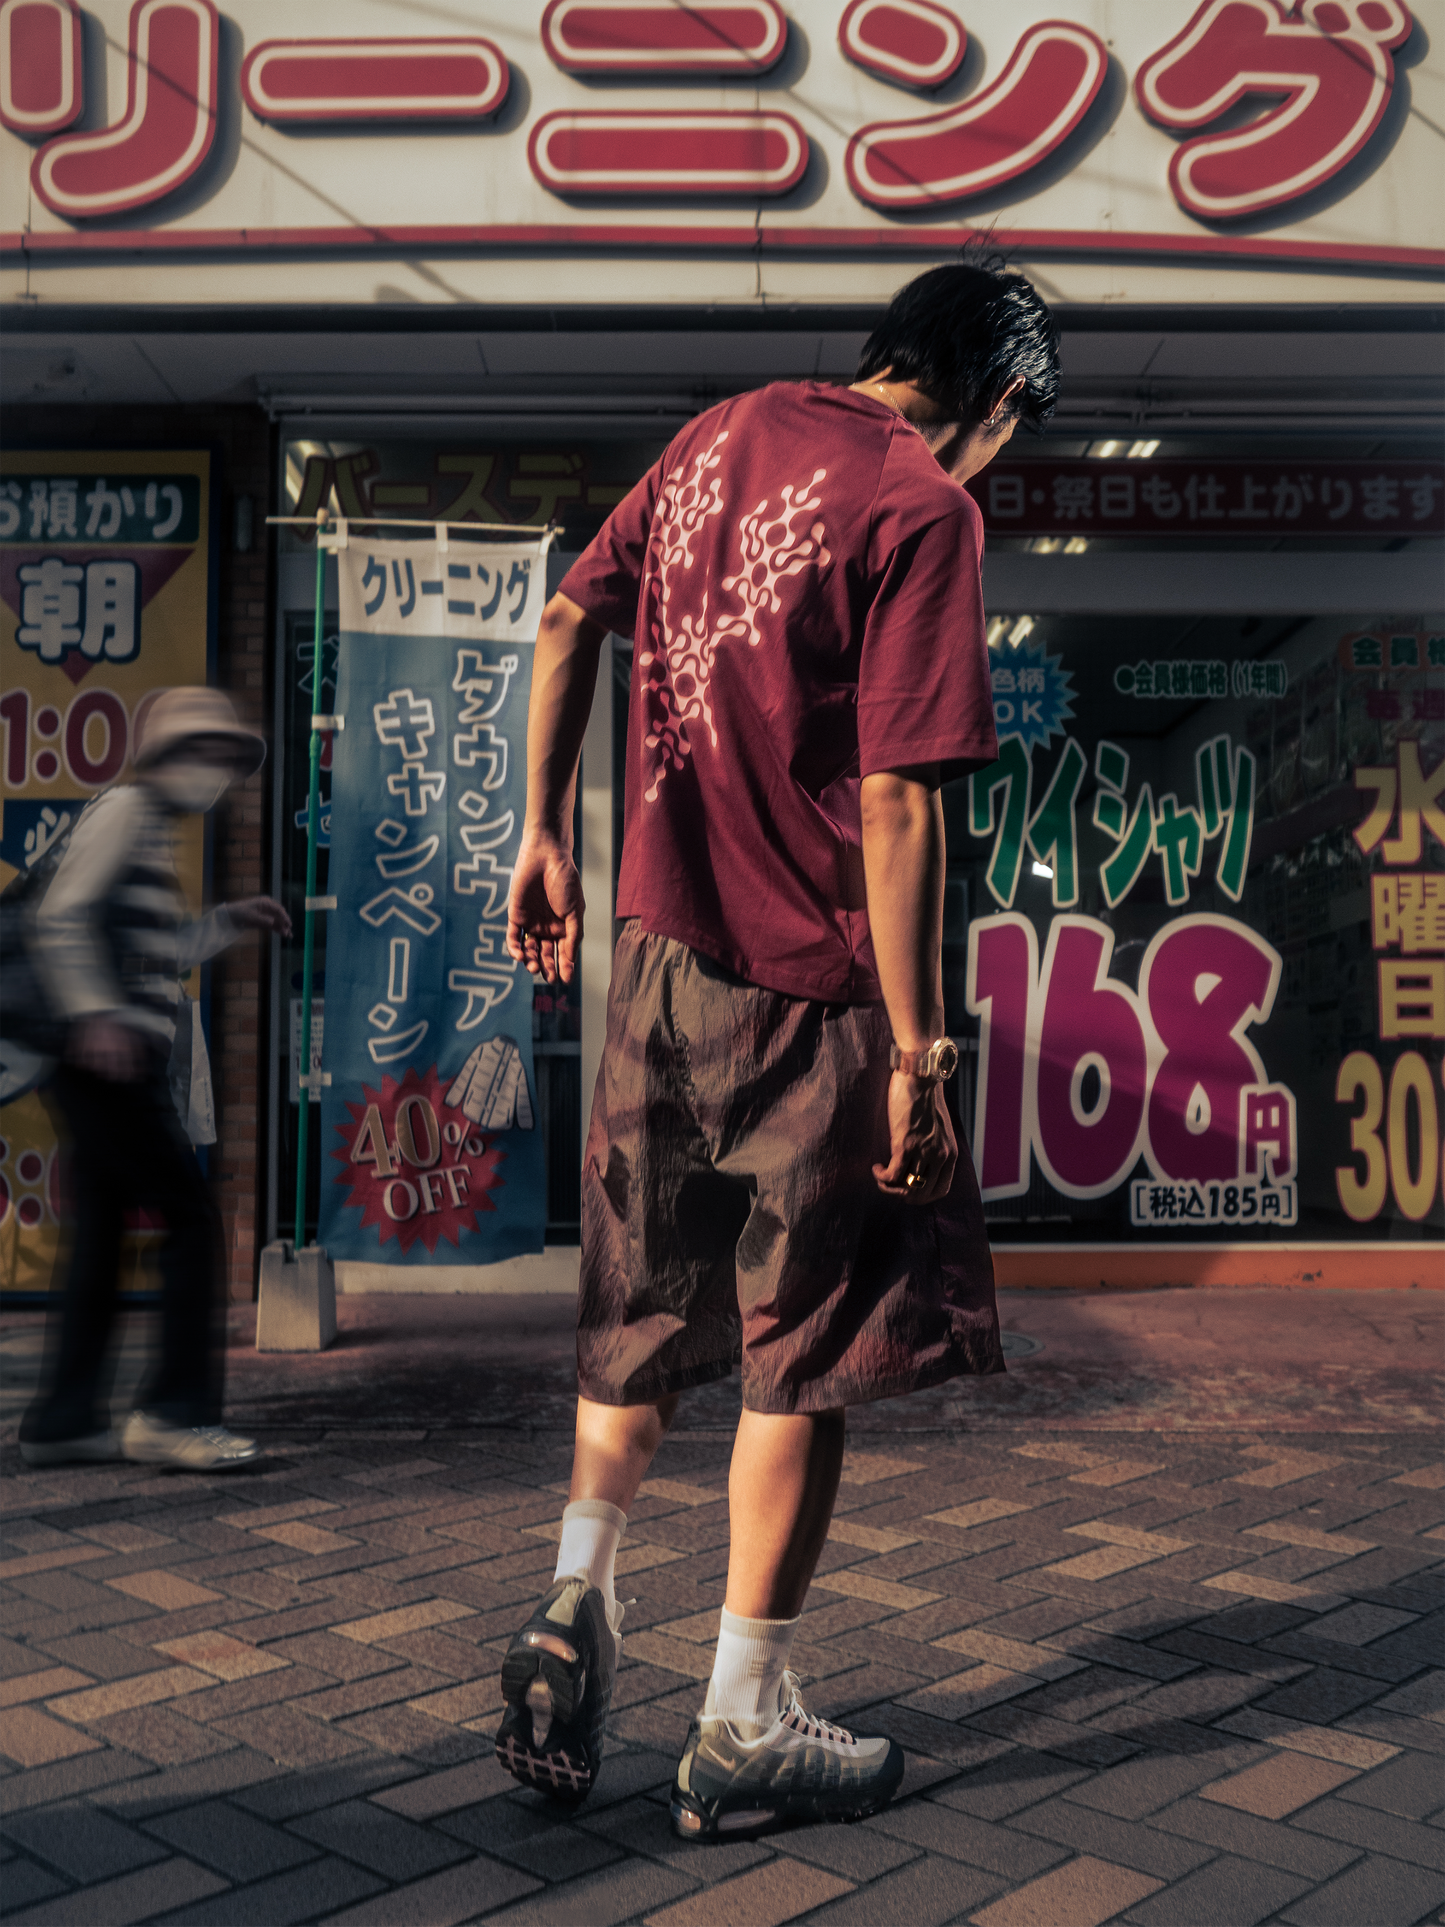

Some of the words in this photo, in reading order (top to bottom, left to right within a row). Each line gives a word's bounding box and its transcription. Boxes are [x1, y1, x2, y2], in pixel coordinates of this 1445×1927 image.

[17, 556, 139, 662] 朝
[361, 554, 532, 625] クリーニング
[993, 698, 1044, 724] OK
[968, 733, 1257, 909] ワイシャツ
[359, 688, 446, 1064] キャンペーン
[350, 1093, 486, 1179] 40%
[1335, 1049, 1445, 1224] 30
[383, 1163, 473, 1222] OFF
